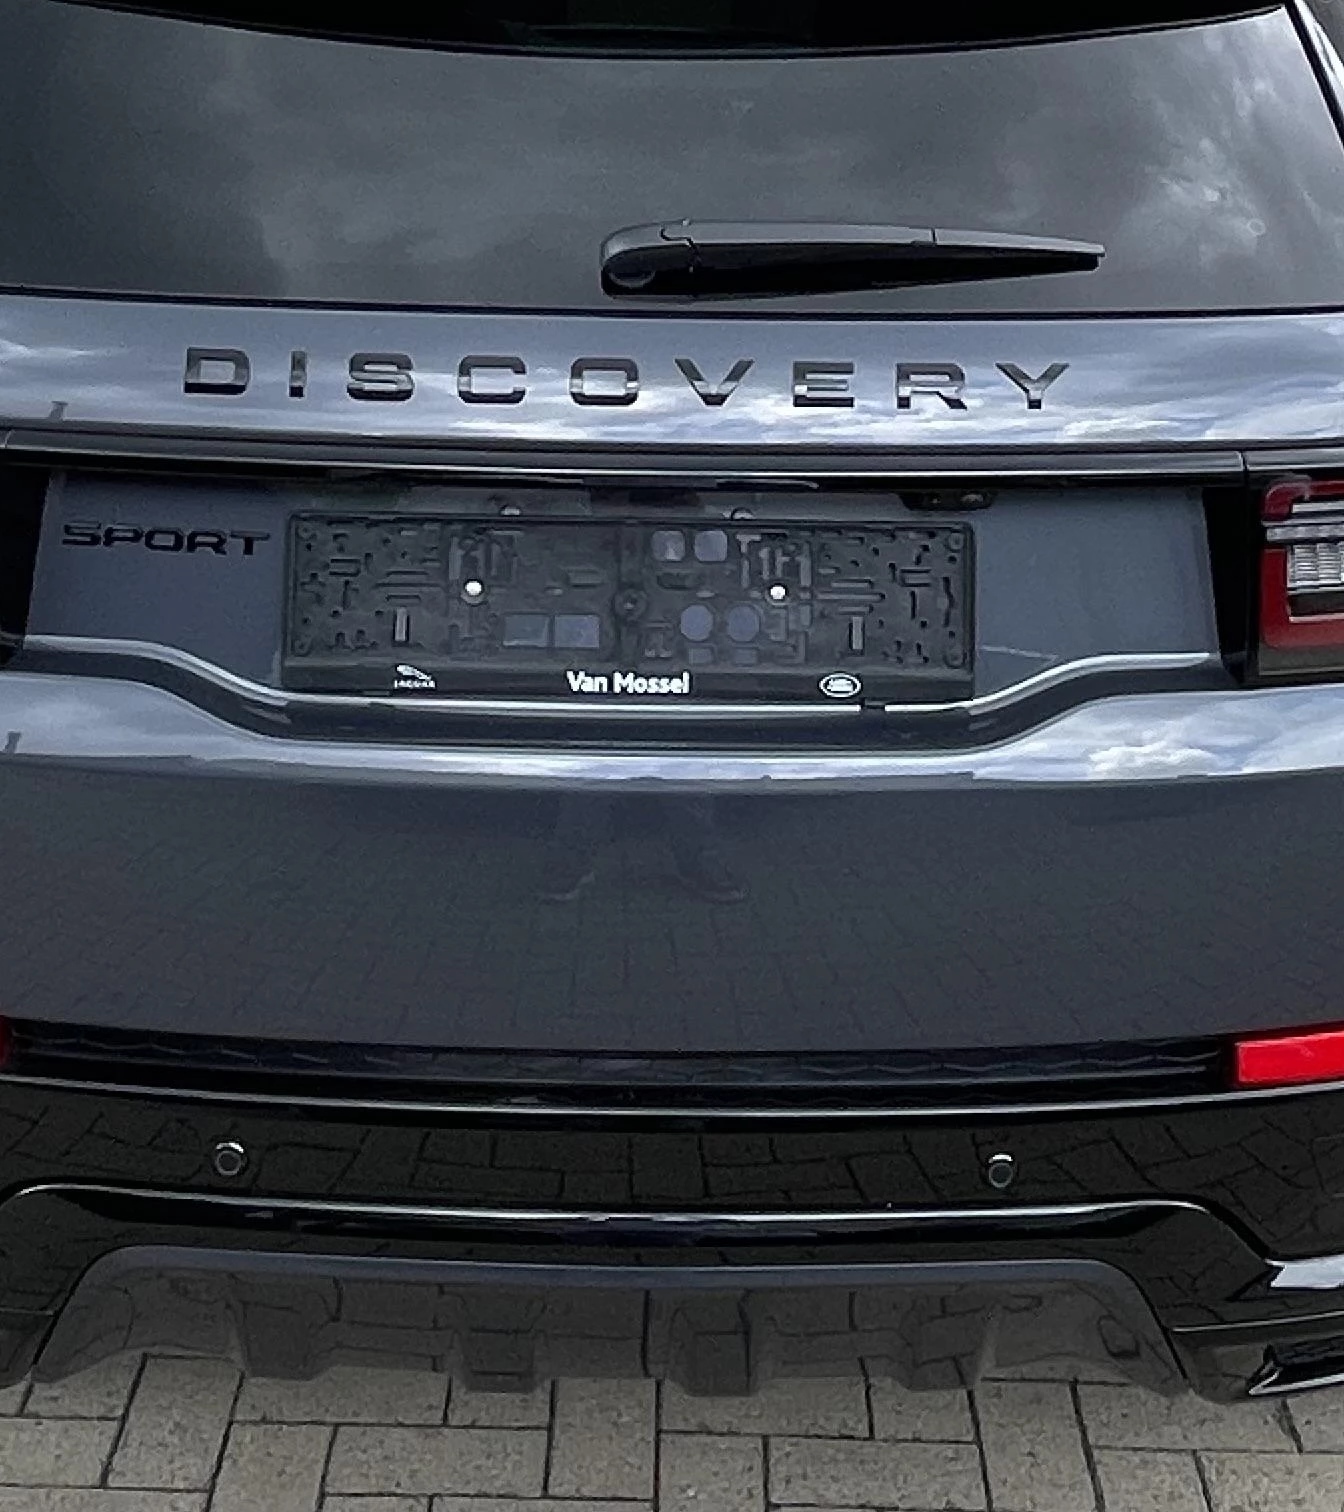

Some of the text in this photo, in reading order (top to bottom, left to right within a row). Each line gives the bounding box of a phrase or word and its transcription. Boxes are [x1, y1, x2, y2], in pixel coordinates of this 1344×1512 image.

[183, 346, 1070, 410] DISCOVERY
[61, 520, 272, 557] SPORT
[566, 670, 690, 695] Van Mossel
